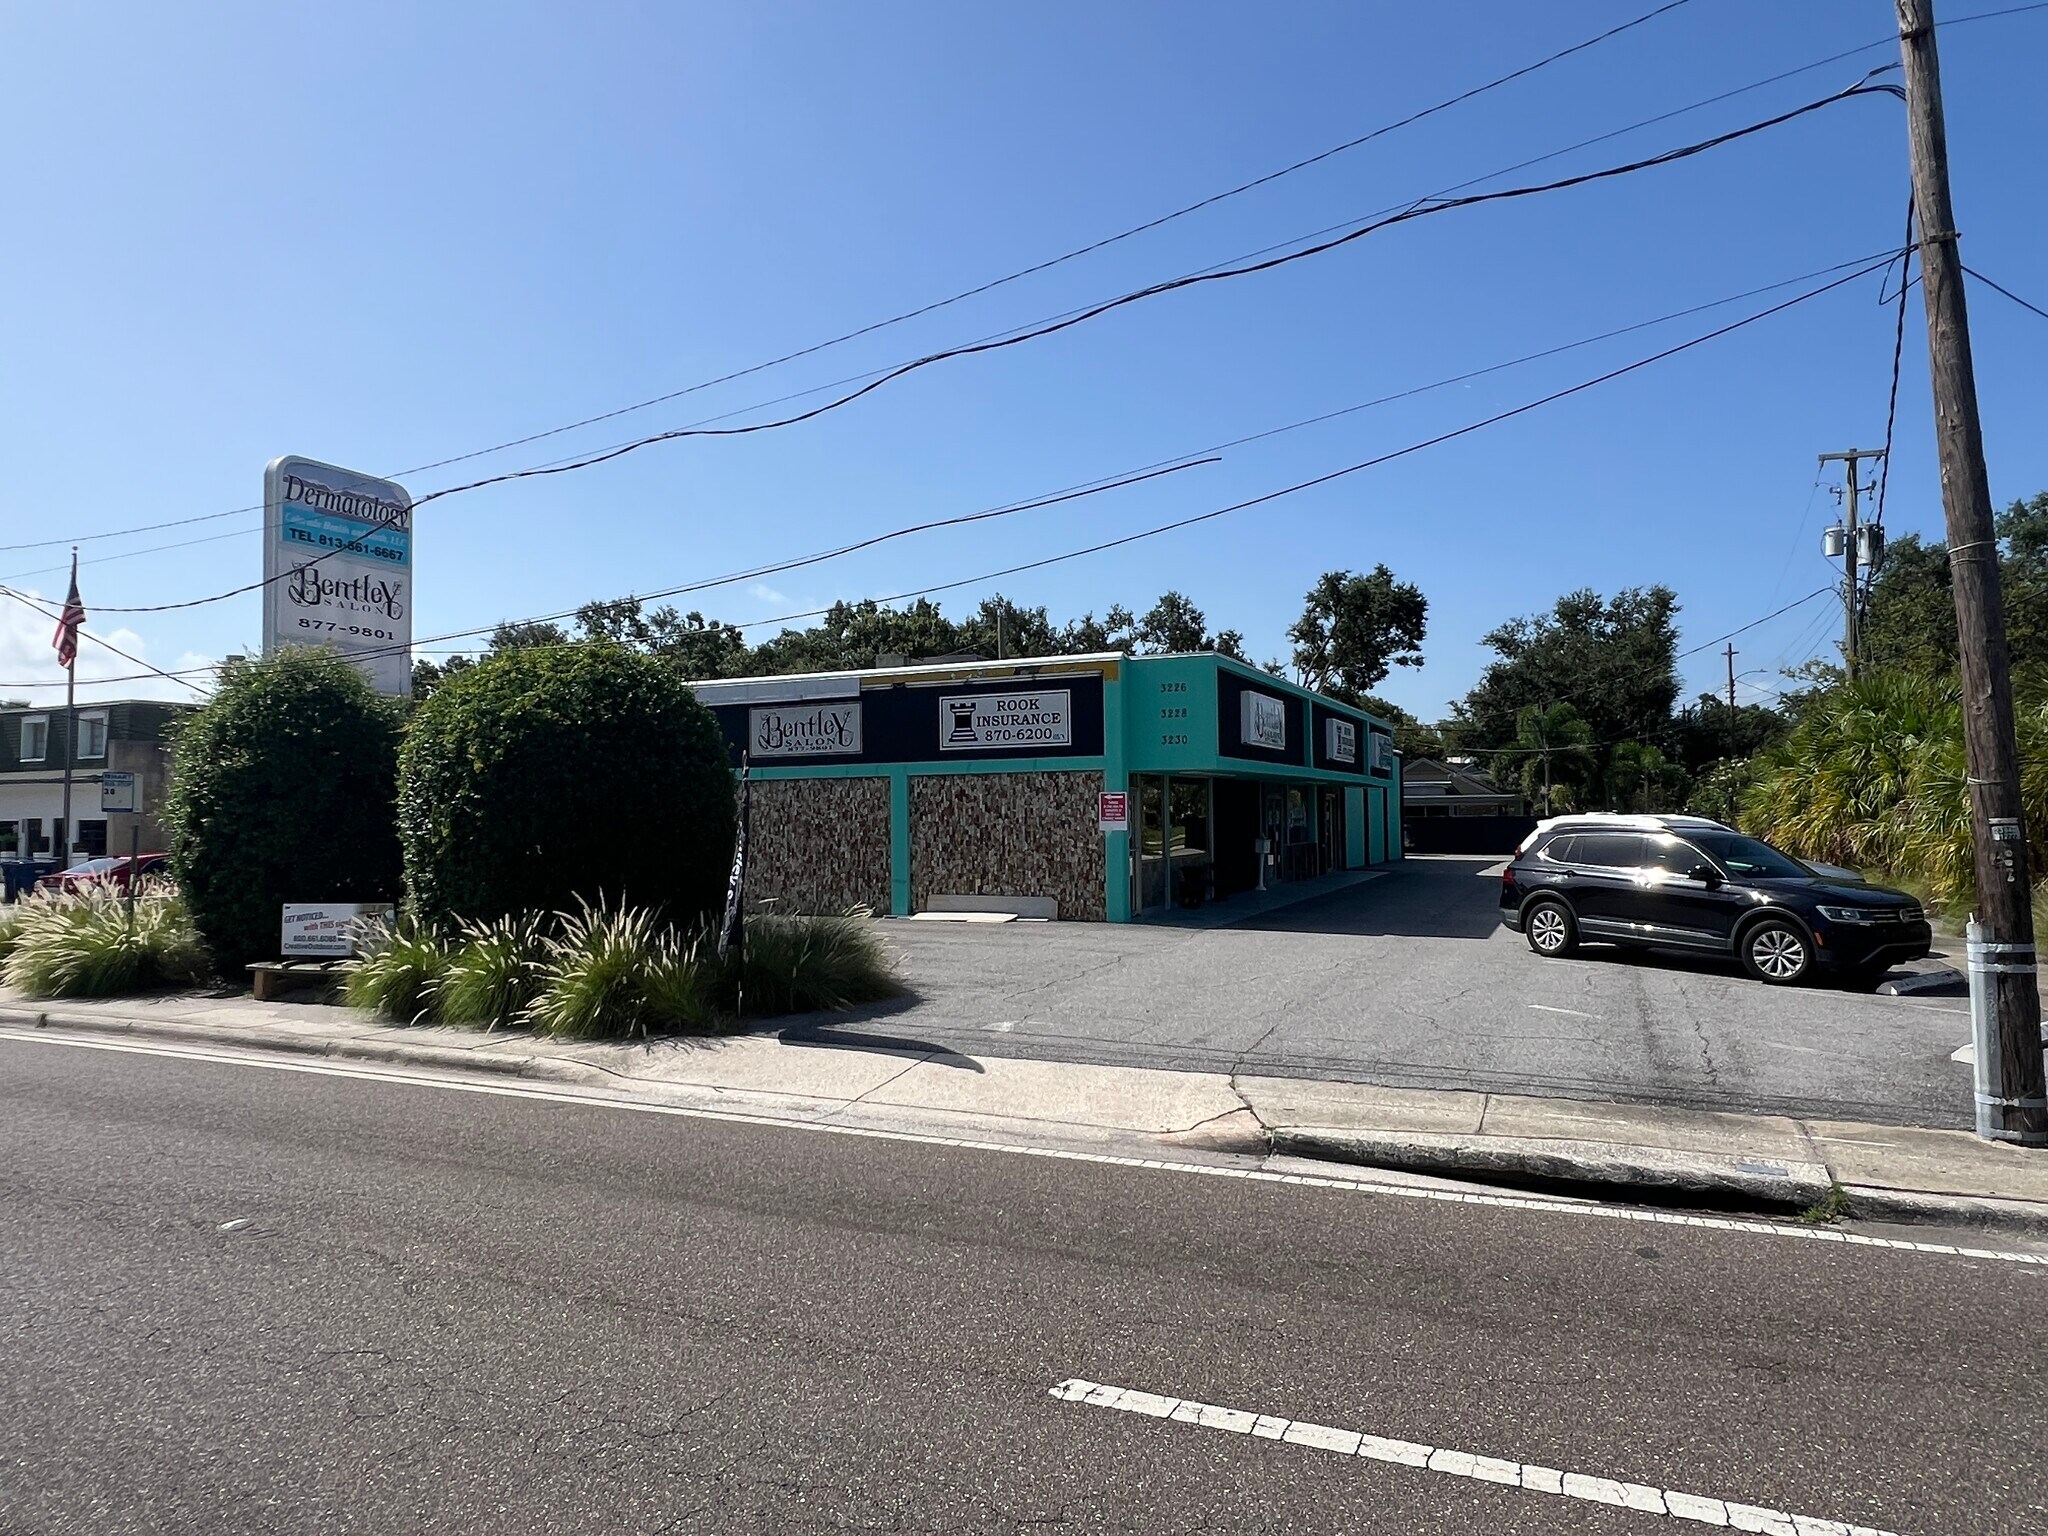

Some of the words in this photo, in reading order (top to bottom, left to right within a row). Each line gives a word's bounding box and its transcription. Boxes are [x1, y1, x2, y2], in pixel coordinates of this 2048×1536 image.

[285, 474, 408, 531] Dermatology
[289, 527, 315, 542] TEL
[323, 599, 384, 615] SALON
[298, 618, 394, 641] 877-9801
[1160, 682, 1187, 693] 3226
[996, 698, 1040, 712] ROOK
[976, 712, 1061, 727] INSURANCE
[1161, 708, 1187, 719] 3228
[985, 728, 1053, 741] 870-6200
[1161, 734, 1188, 745] 3230
[785, 737, 836, 748] SALON
[320, 920, 335, 929] THIS
